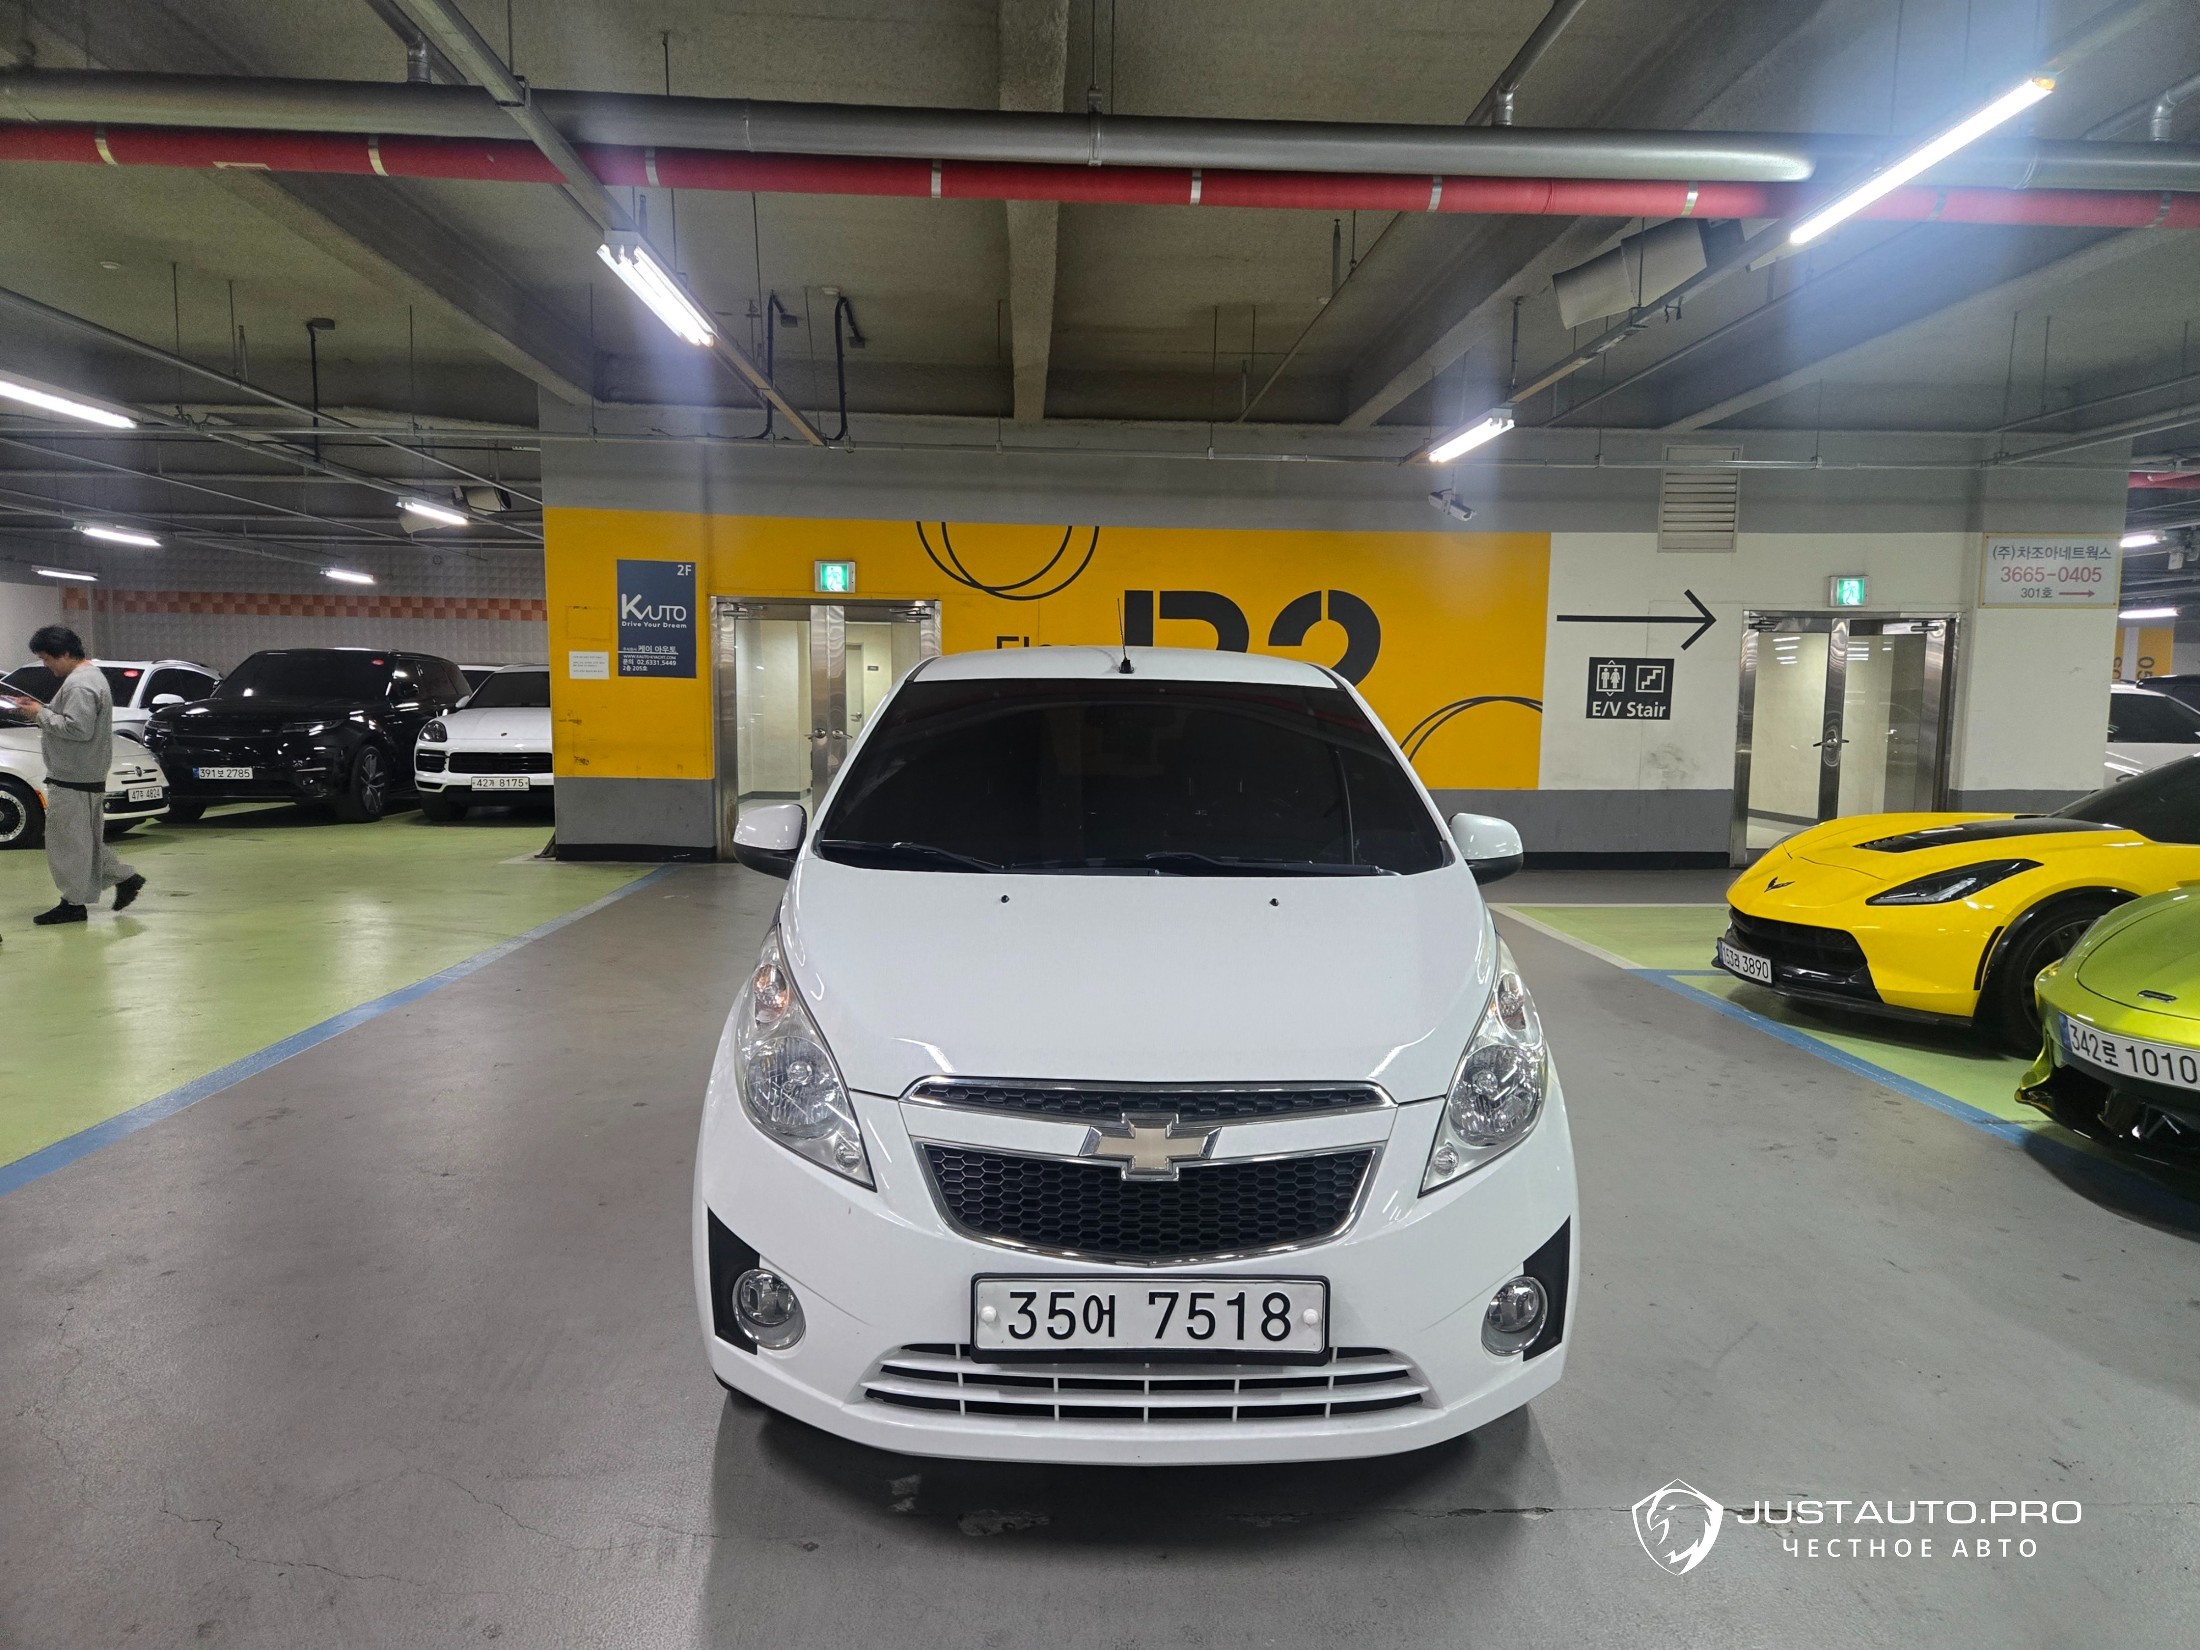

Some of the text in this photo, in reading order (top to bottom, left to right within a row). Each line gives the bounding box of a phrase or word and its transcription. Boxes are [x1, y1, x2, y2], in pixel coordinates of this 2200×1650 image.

[677, 564, 692, 576] 2F
[2000, 566, 2102, 583] 3665-0405
[2020, 587, 2053, 599] 301호
[655, 646, 677, 654] 아우토
[1592, 701, 1666, 717] E/V Stair
[200, 769, 225, 778] 391보
[226, 769, 250, 778] 2785
[499, 779, 524, 787] 8175
[1742, 955, 1769, 979] 3890
[2070, 1024, 2198, 1084] 342로 1010
[1008, 1291, 1291, 1342] 35어 7518
